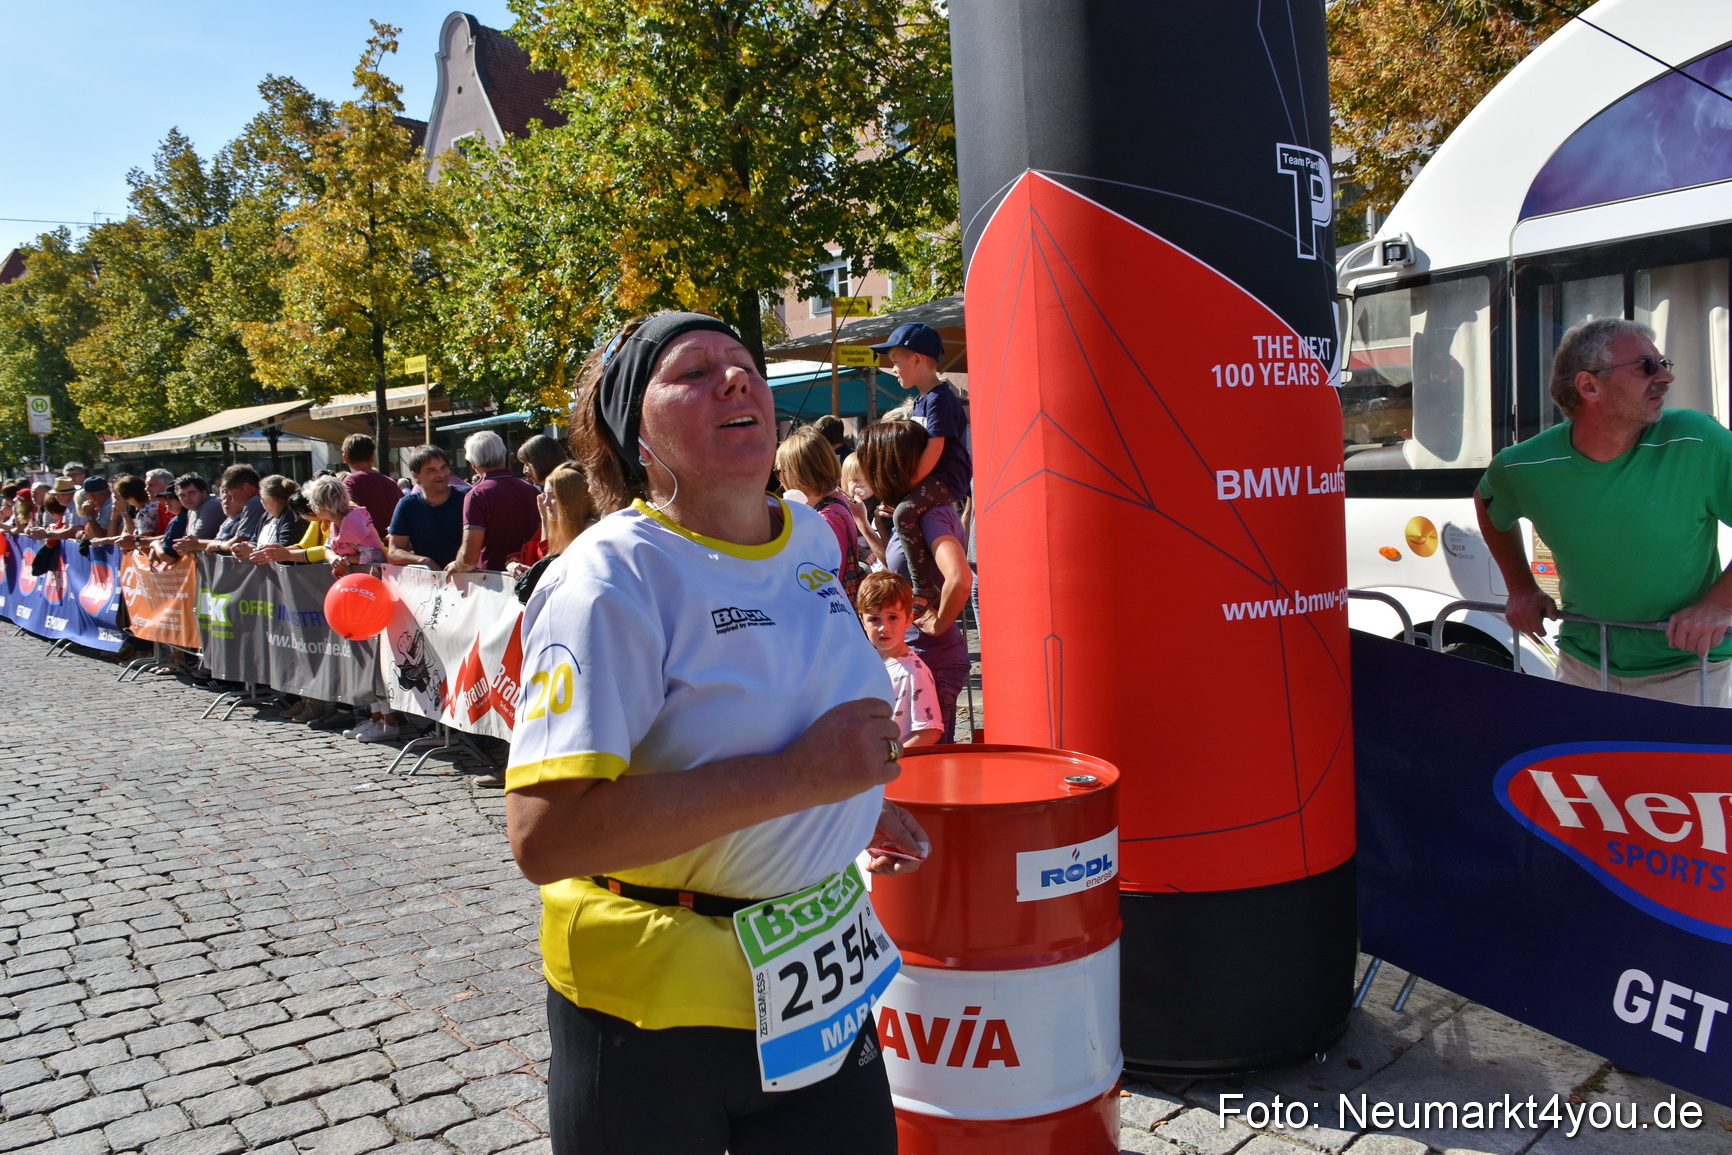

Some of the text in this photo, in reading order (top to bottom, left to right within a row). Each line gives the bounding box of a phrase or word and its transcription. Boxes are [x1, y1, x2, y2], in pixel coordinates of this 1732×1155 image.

[1282, 153, 1305, 167] Team
[1252, 335, 1331, 361] THE NEXT
[1211, 362, 1320, 388] 100 YEARS
[1216, 466, 1301, 500] BMW
[799, 568, 834, 591] 20
[711, 607, 772, 628] BOCK
[525, 662, 574, 721] 20
[1085, 870, 1113, 888] energie
[1606, 840, 1727, 892] SPORTS
[778, 911, 880, 1022] 2554
[1613, 968, 1729, 1053] GET
[858, 1047, 878, 1067] adidas
